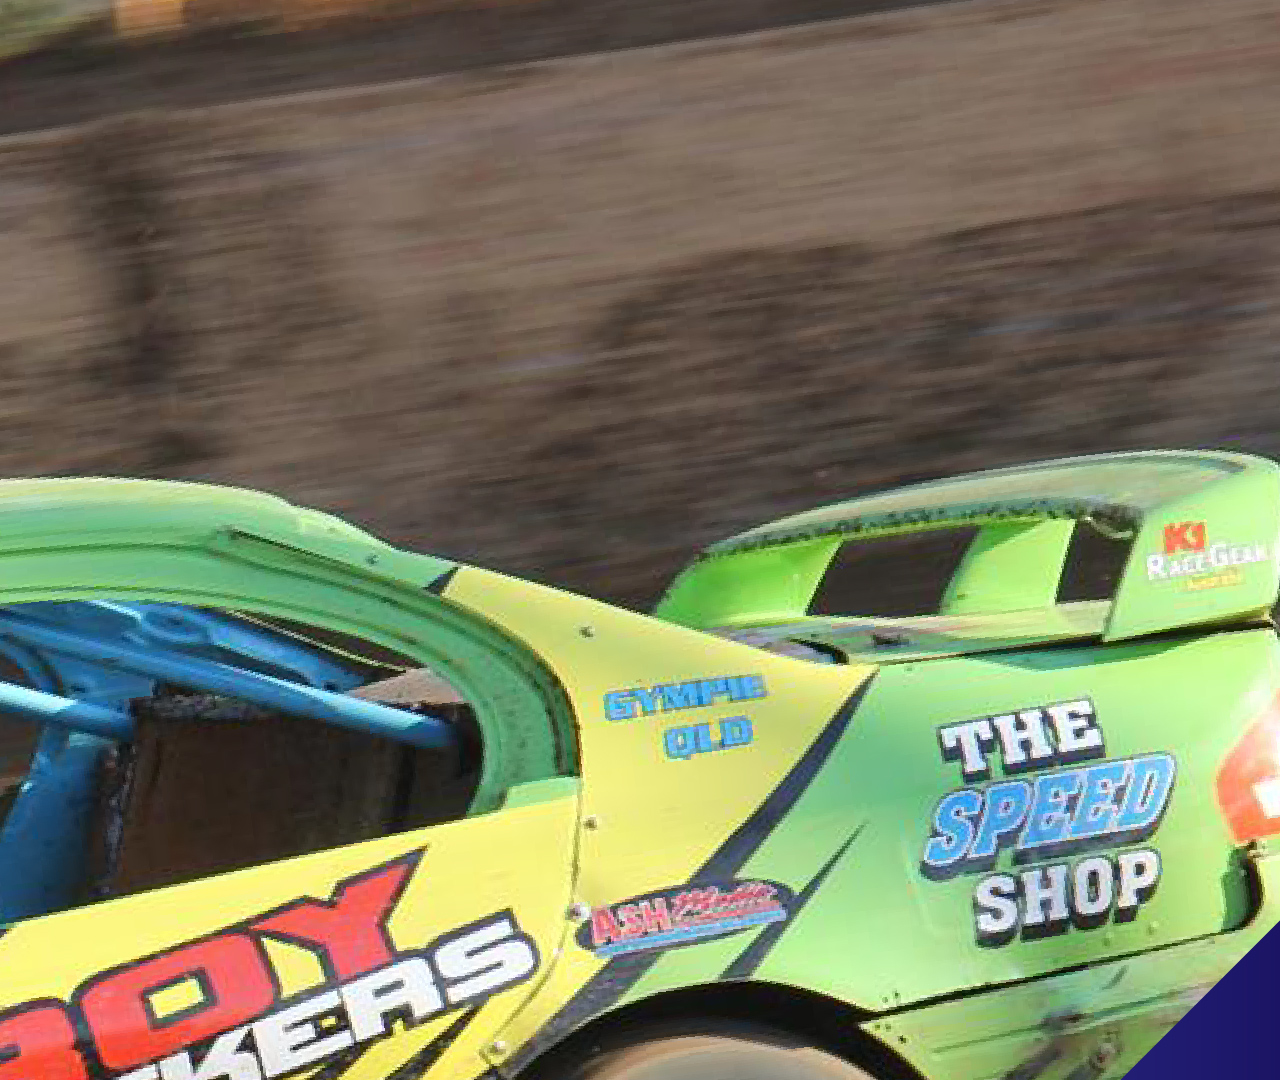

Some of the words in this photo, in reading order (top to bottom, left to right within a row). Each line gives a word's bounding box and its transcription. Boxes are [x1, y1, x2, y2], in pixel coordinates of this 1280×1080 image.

[603, 674, 770, 722] GYMPIE
[662, 714, 754, 760] QLD
[937, 696, 1105, 780] THE
[921, 752, 1177, 876] SPEED
[591, 896, 672, 944] ASH
[973, 848, 1162, 944] SHOP
